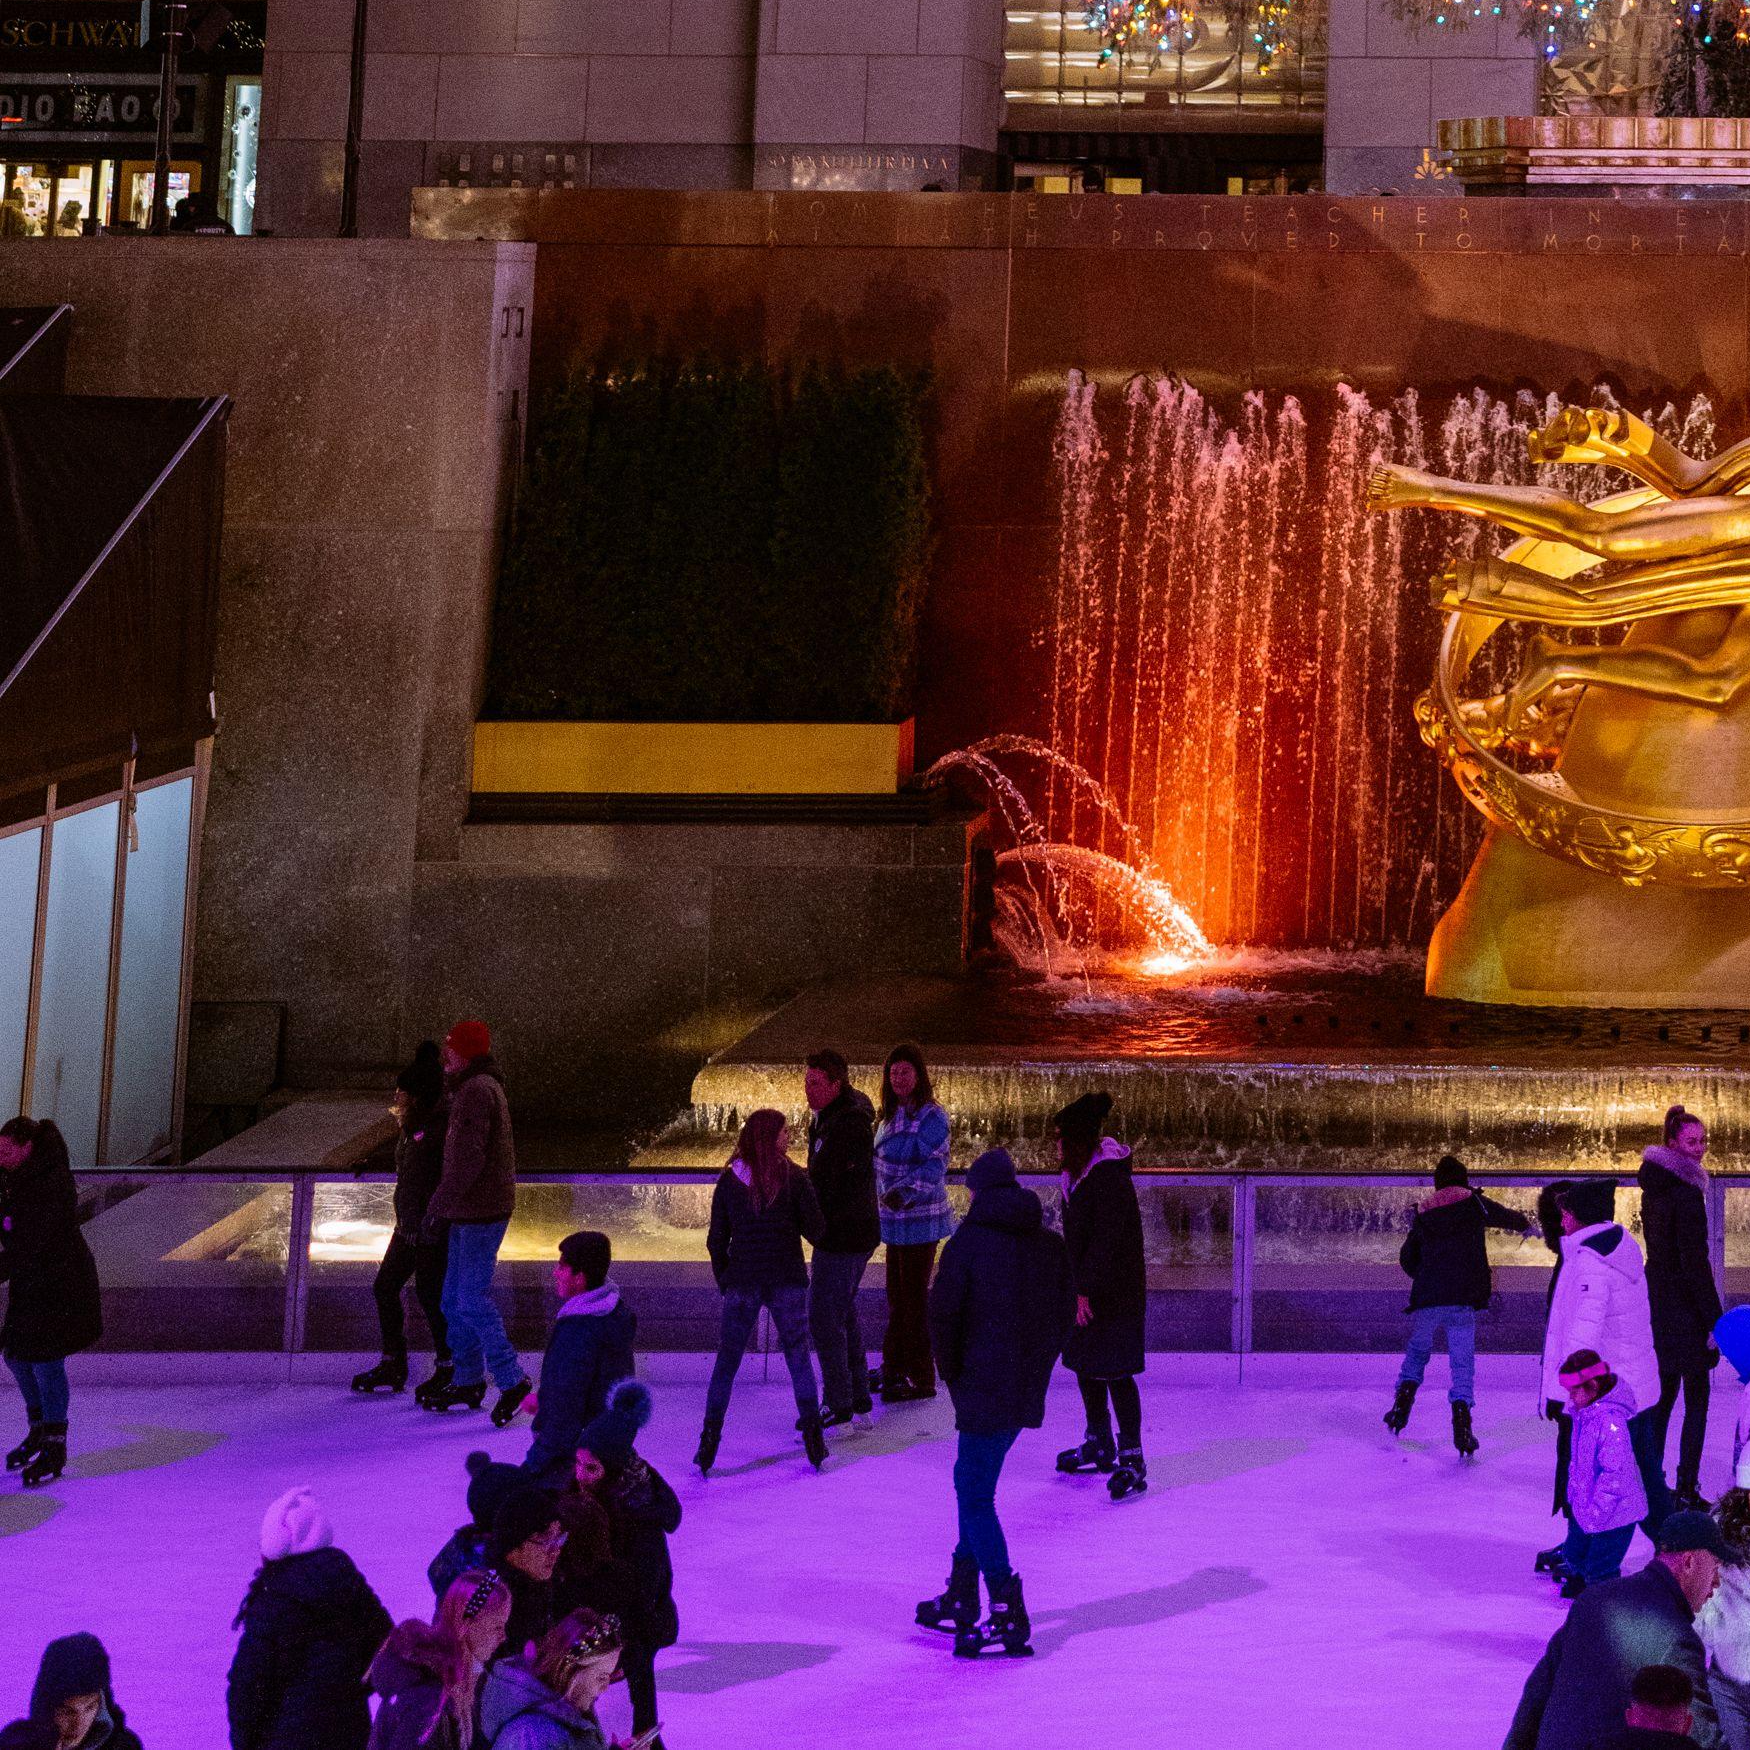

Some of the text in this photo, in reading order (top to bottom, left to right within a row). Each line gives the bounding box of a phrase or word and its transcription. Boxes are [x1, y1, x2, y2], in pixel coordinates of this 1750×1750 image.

[1198, 203, 1472, 225] TEACHER
[1547, 206, 1603, 225] IN
[1109, 230, 1340, 250] PROVED
[1416, 232, 1474, 250] TO
